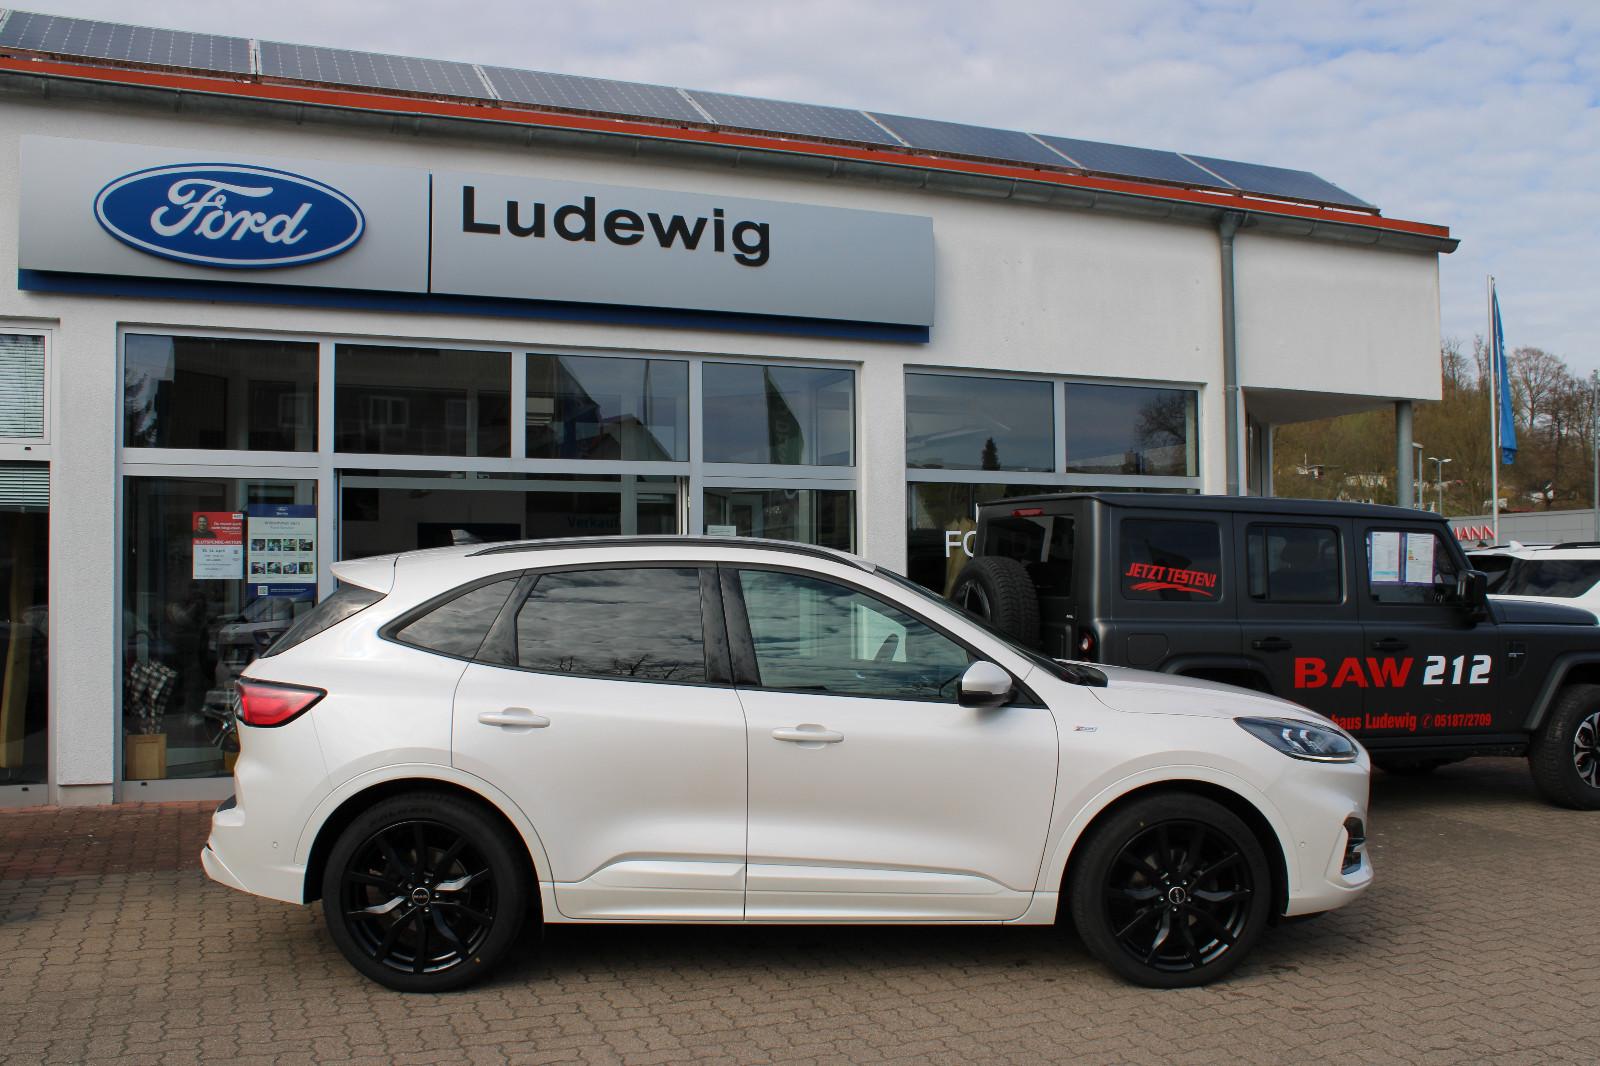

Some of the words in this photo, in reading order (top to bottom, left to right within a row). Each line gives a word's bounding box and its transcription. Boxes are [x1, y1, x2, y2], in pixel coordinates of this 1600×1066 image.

[150, 178, 312, 245] Ford
[462, 185, 770, 267] Ludewig
[1126, 562, 1166, 580] JETZT
[1166, 567, 1217, 588] TESTEN!
[1294, 657, 1414, 689] BAW
[1423, 654, 1492, 686] 212
[1365, 712, 1416, 732] Ludewig
[1434, 713, 1492, 728] 05187/2709
